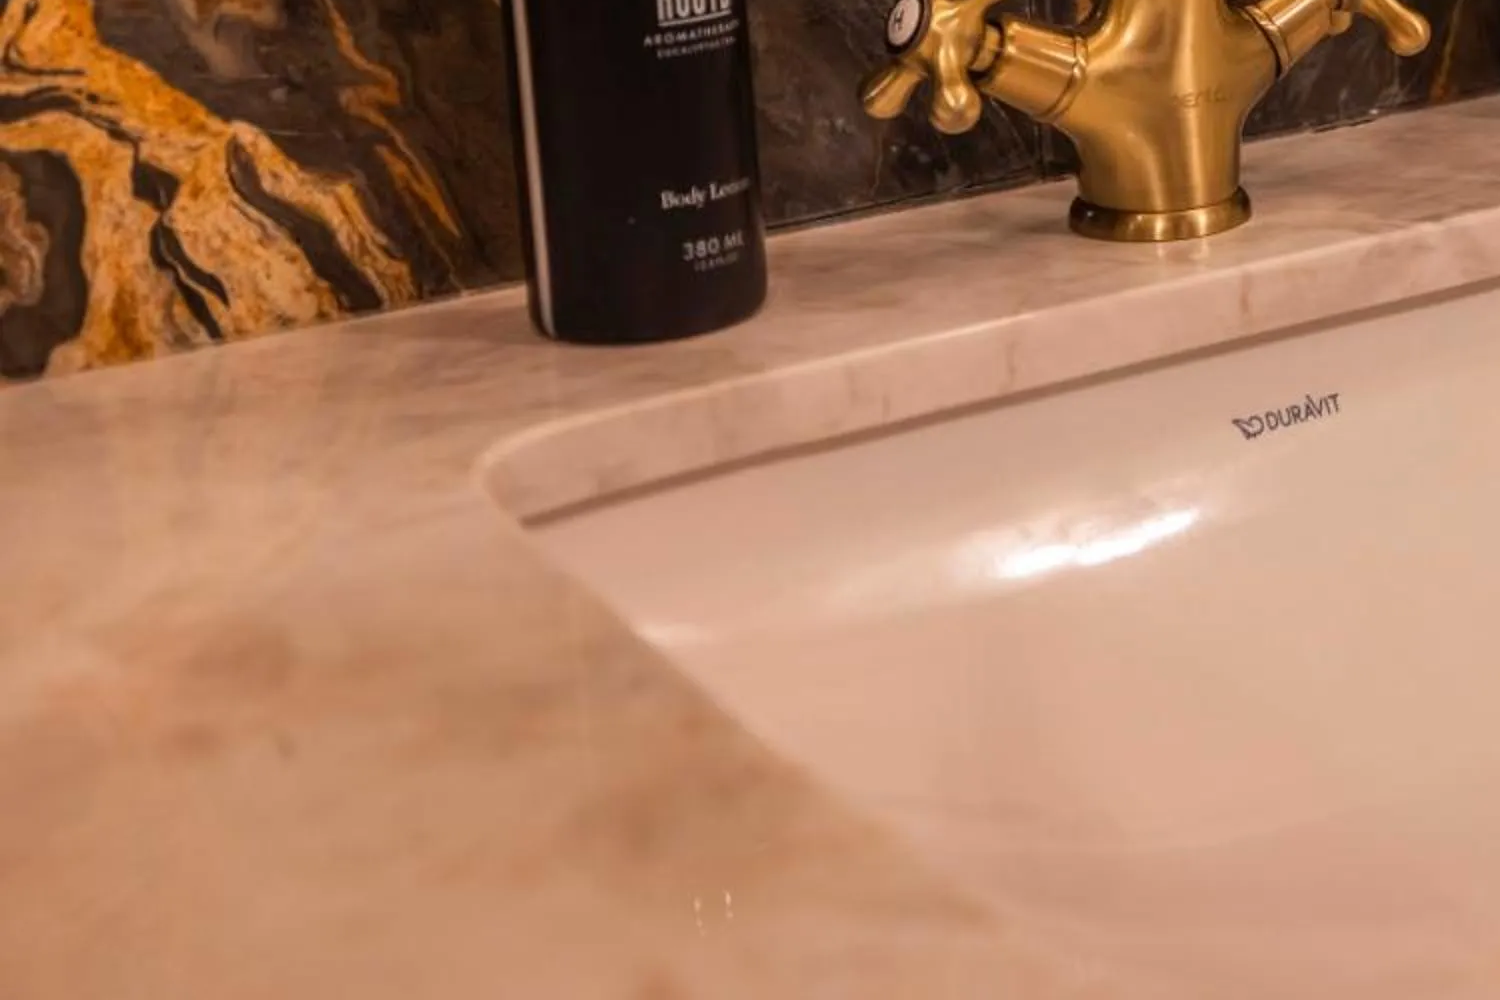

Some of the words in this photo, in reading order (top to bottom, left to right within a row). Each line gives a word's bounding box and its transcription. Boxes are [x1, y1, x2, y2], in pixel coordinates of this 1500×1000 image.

[661, 184, 705, 210] Body
[682, 236, 719, 261] 380
[1264, 392, 1339, 431] DURAVIT
